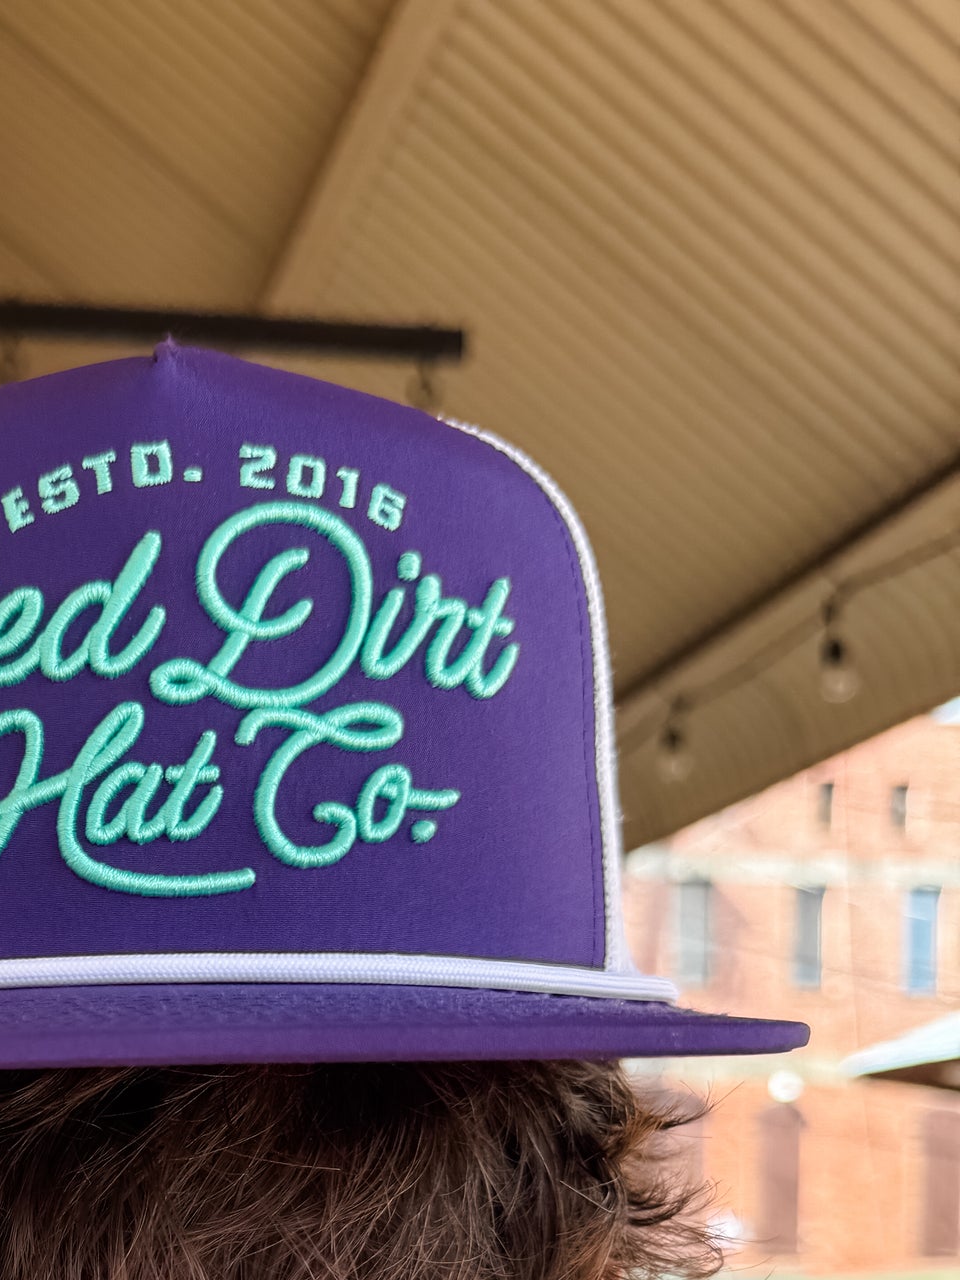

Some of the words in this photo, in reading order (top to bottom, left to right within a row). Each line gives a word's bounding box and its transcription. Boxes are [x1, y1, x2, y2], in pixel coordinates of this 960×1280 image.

[1, 440, 203, 532] ESTD.
[239, 444, 408, 531] 2016
[149, 501, 520, 709] Dirt
[235, 701, 460, 869] Co.
